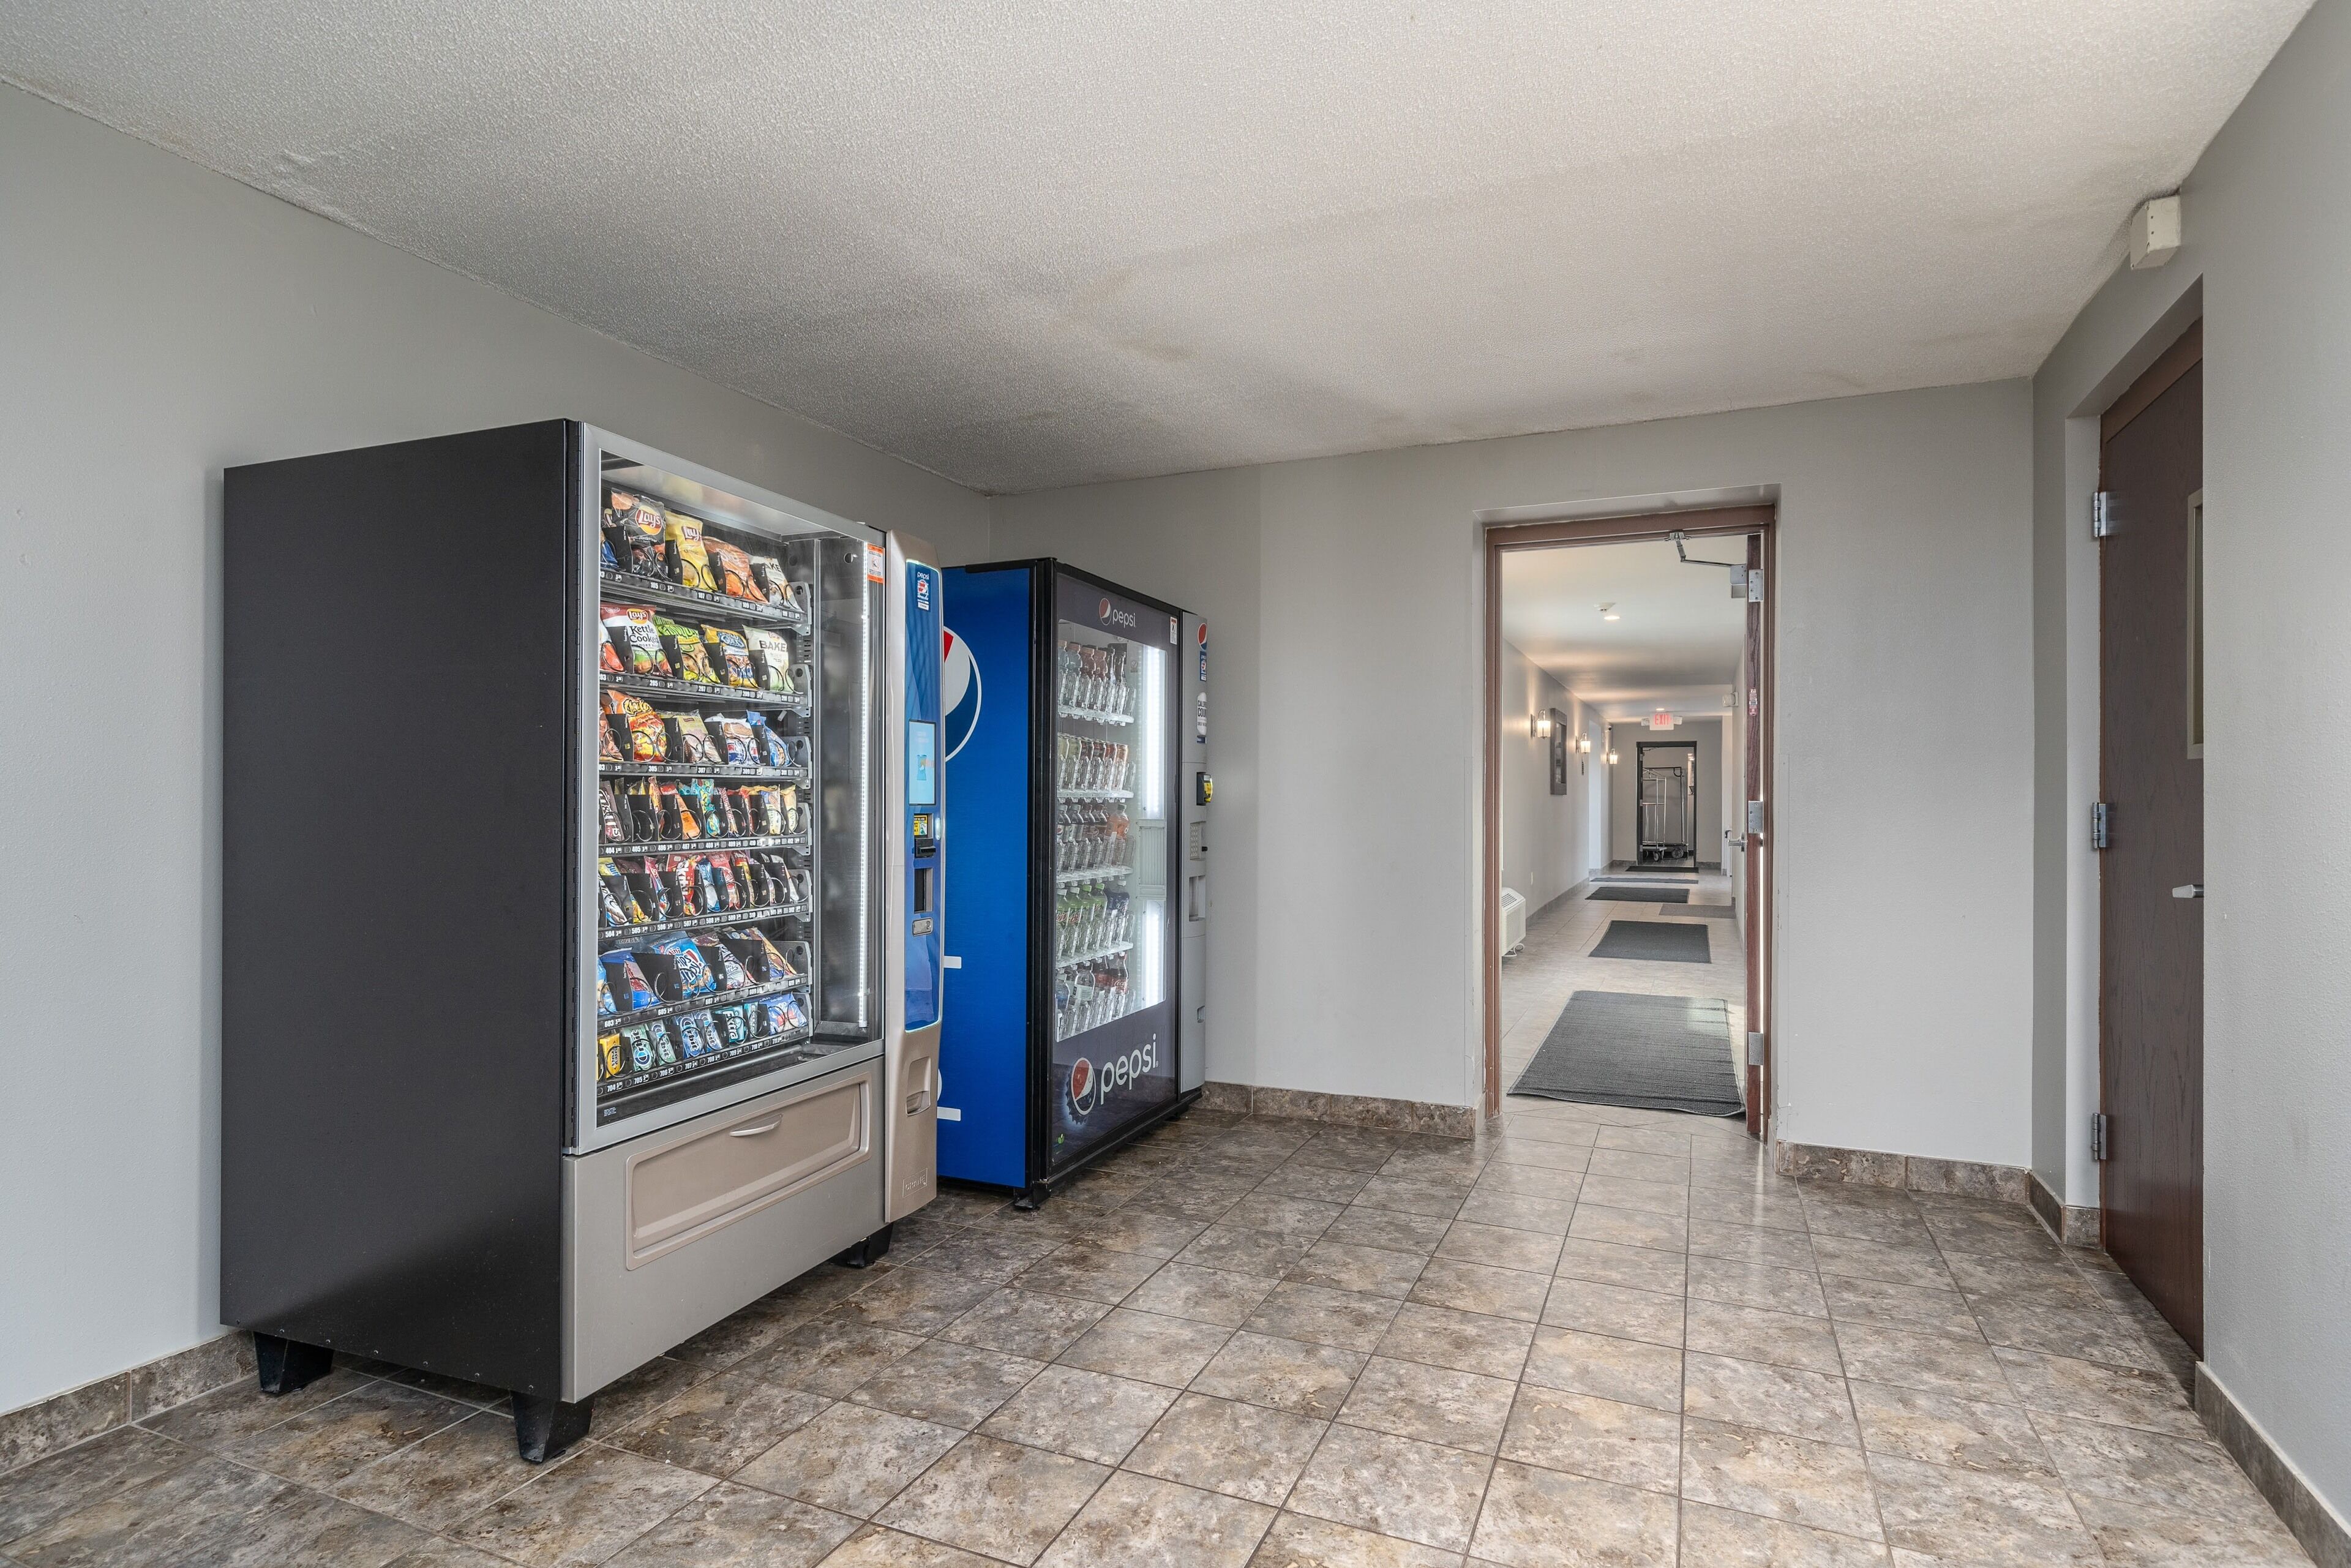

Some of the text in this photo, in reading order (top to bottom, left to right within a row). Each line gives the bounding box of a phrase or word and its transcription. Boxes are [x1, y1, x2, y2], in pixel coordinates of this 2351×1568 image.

[1112, 608, 1136, 628] pepsi
[629, 626, 655, 635] Kettle
[629, 634, 659, 643] Cooked
[759, 640, 787, 652] BAKE
[1655, 714, 1670, 726] EXIT
[1101, 1033, 1157, 1105] pepsi
